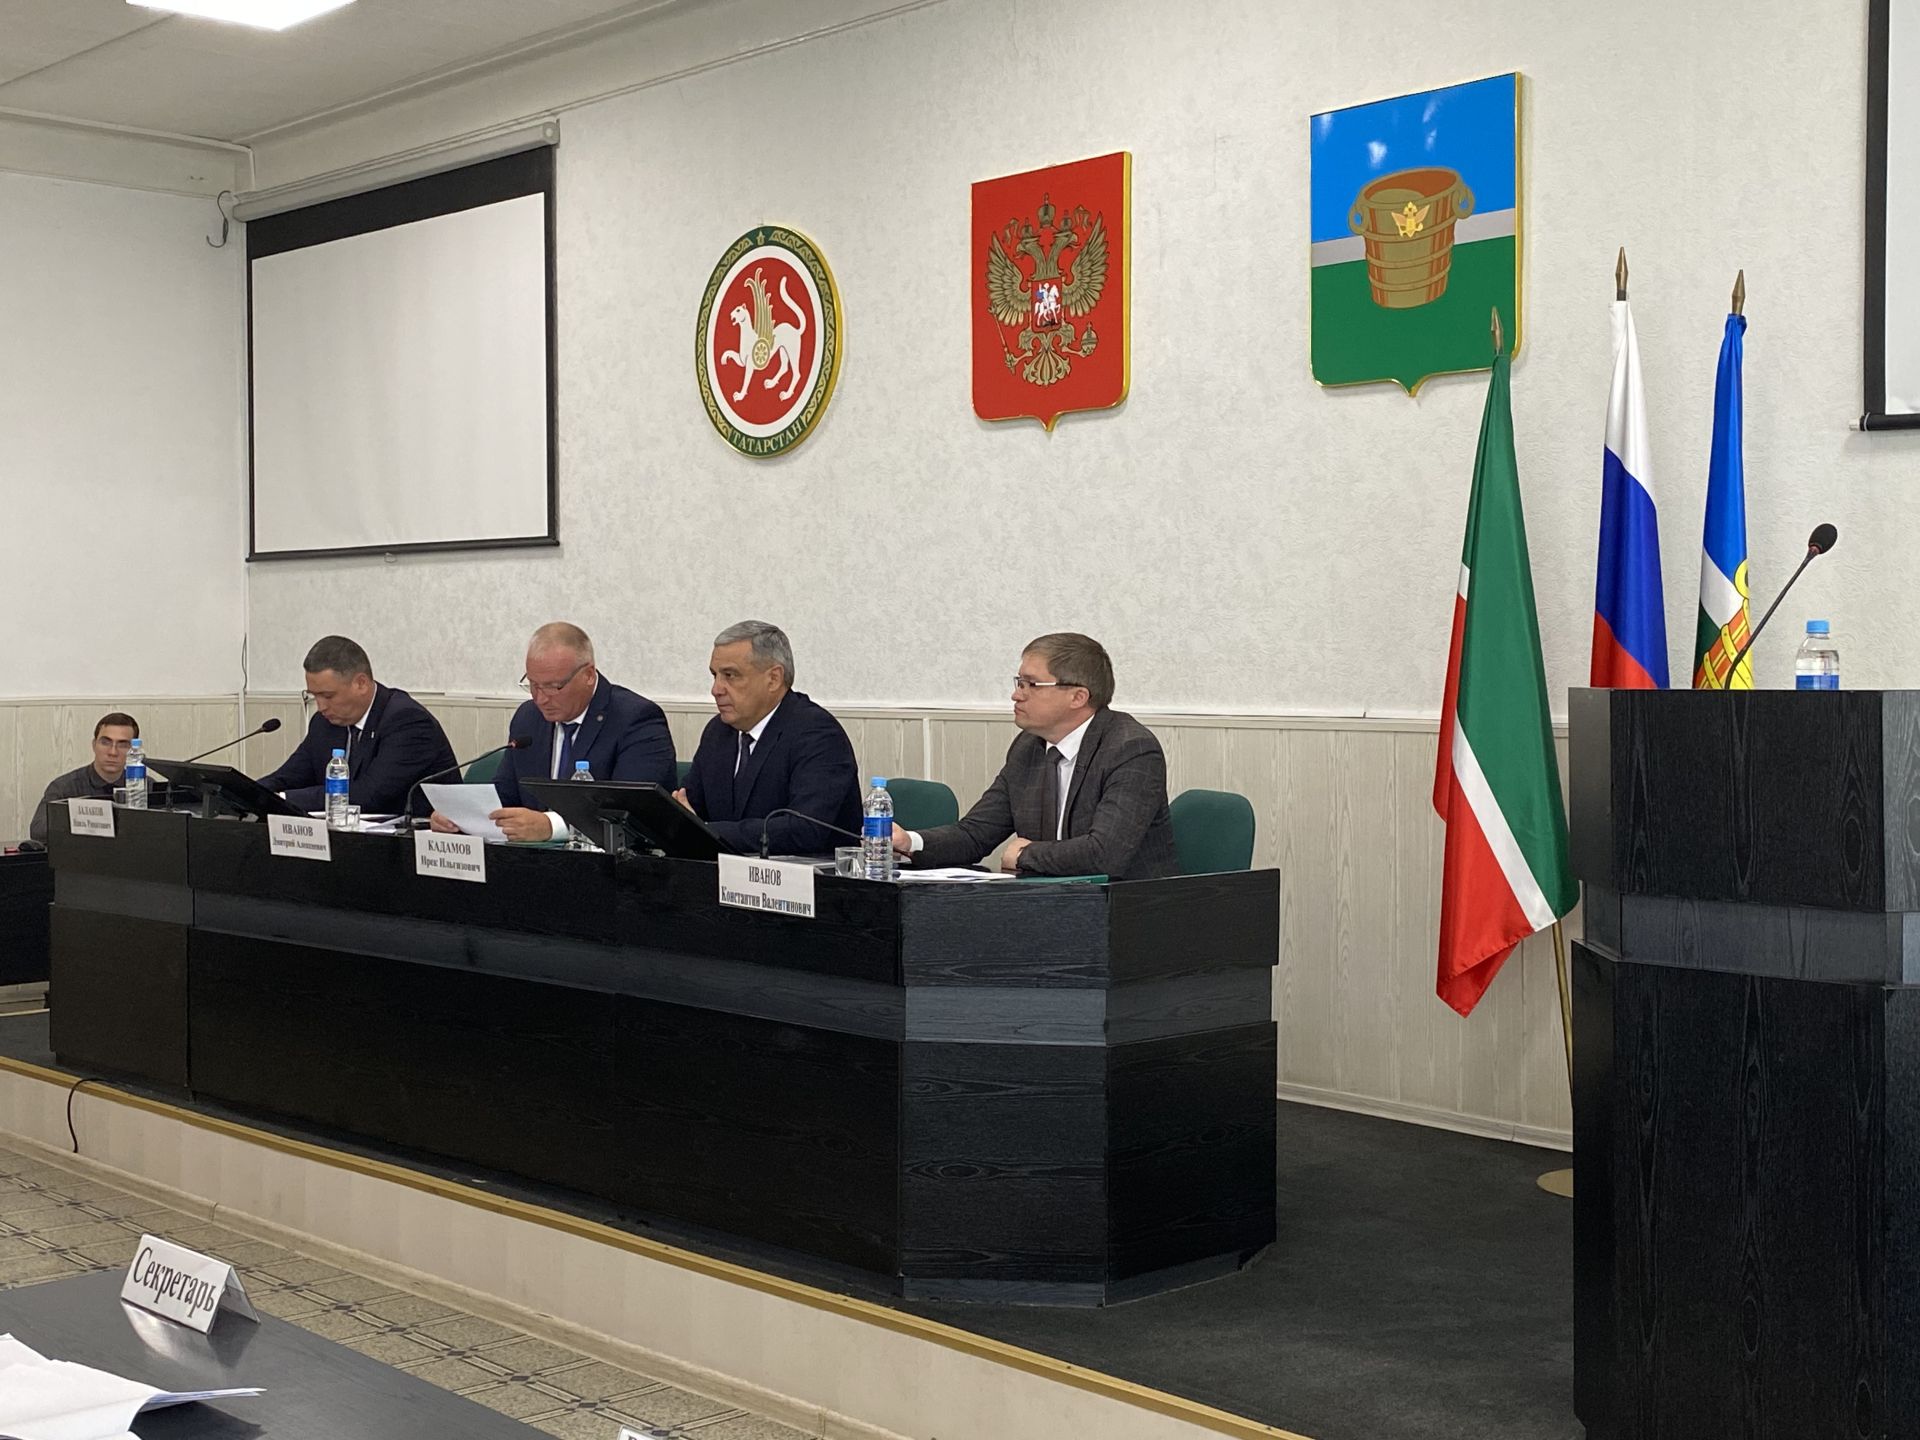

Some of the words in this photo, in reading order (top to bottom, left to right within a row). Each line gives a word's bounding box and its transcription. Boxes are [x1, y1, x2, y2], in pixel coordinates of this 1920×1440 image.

[732, 419, 802, 453] ТАТАРСТАН
[282, 823, 314, 836] ИВАНОВ
[428, 839, 471, 855] КАДАМОВ
[421, 855, 438, 868] Ирек
[748, 866, 782, 886] ИВАНОВ
[721, 886, 761, 908] Константин
[761, 892, 812, 916] Валентинович
[133, 1246, 216, 1318] Секретарь
